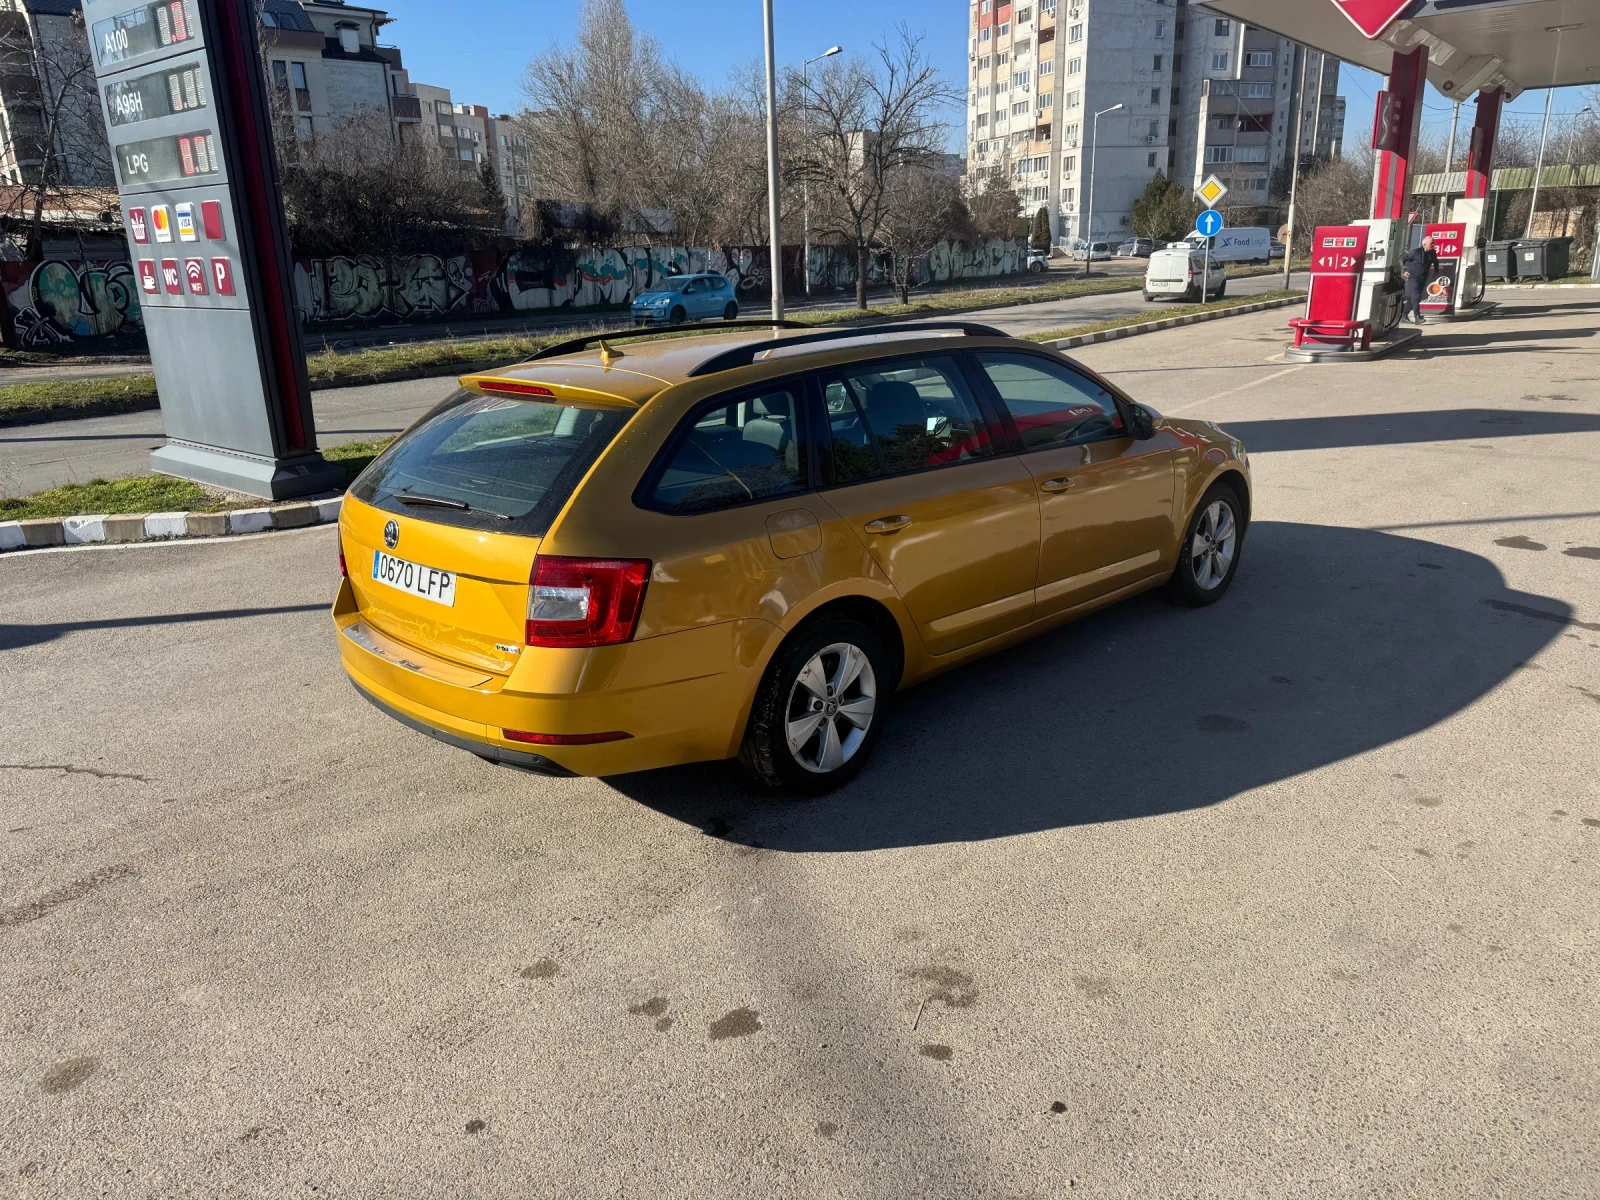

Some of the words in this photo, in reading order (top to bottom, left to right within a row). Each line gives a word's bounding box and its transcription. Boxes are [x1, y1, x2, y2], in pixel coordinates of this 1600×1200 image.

[105, 28, 129, 54] A100
[116, 91, 144, 116] A95H
[126, 153, 149, 175] LPG
[181, 218, 191, 228] VISA
[1234, 237, 1250, 246] Food
[1251, 237, 1267, 247] Logic
[163, 268, 178, 286] WC
[215, 262, 225, 290] P
[380, 554, 414, 589] 0670
[417, 566, 451, 599] LFP
